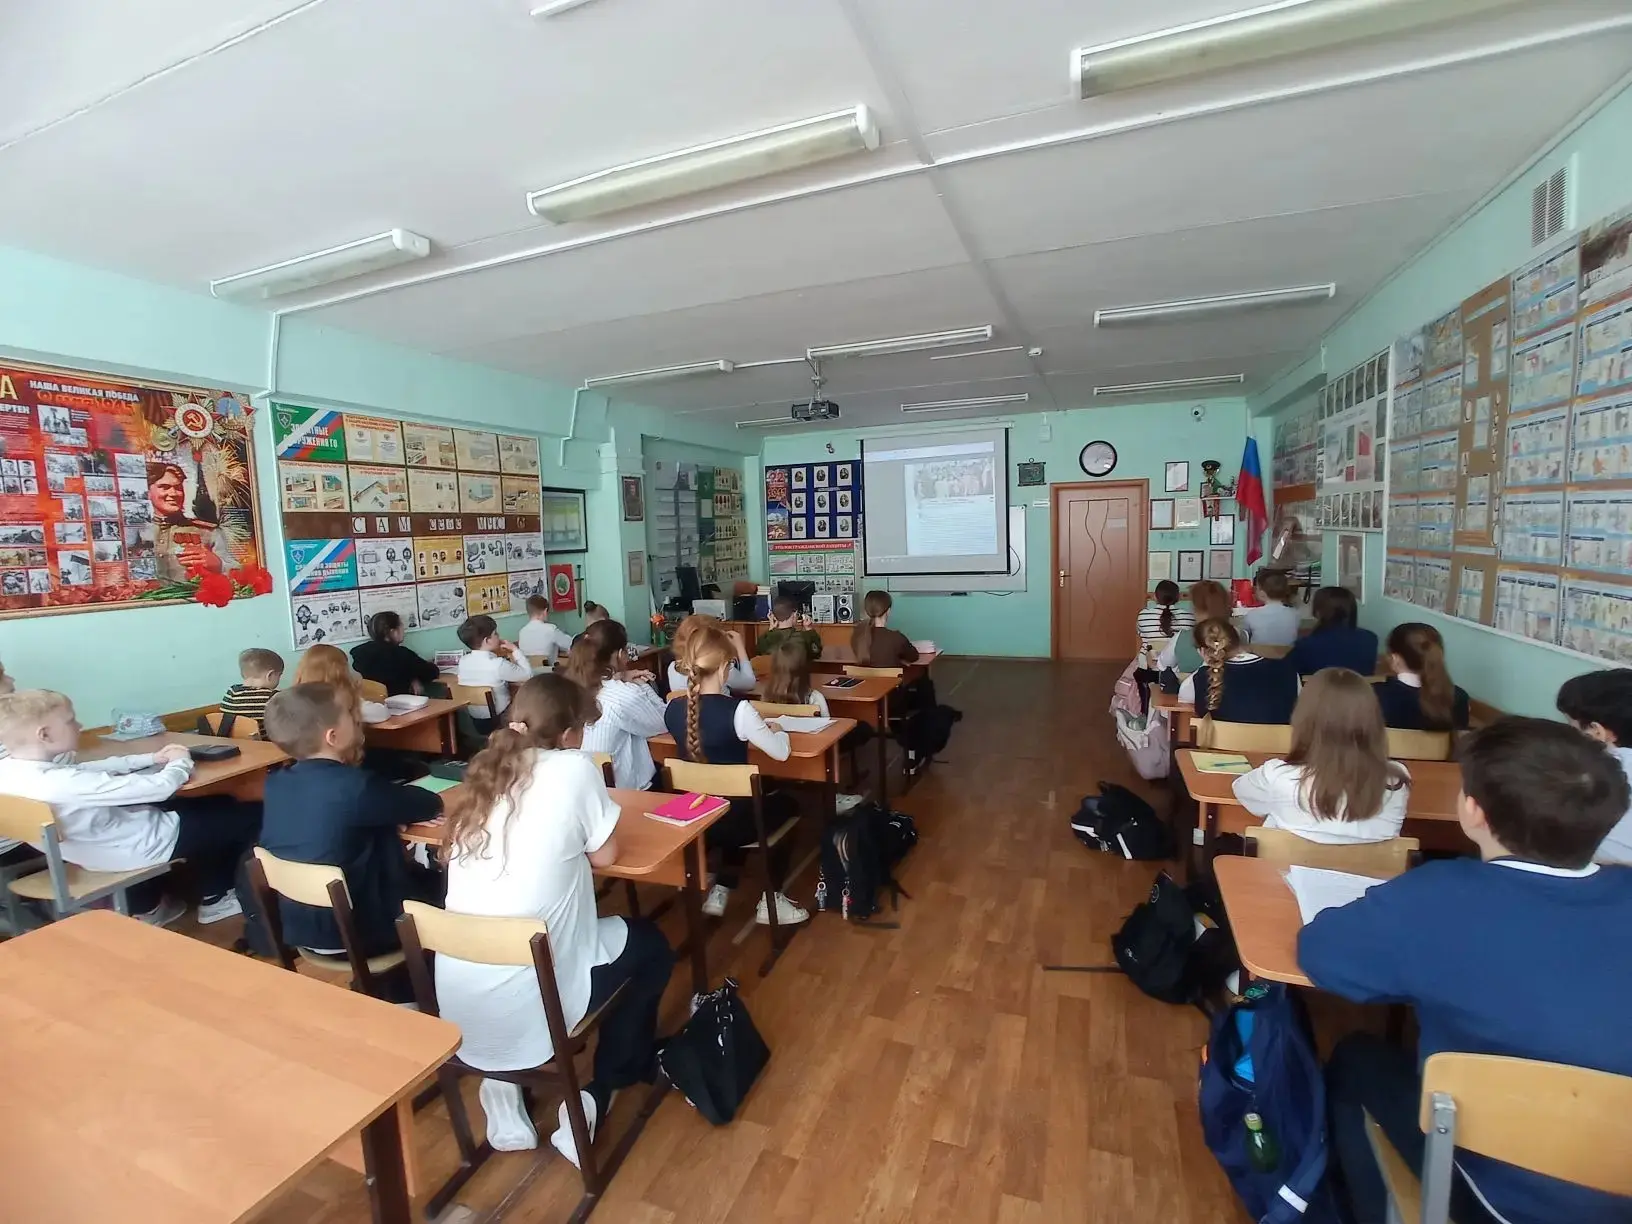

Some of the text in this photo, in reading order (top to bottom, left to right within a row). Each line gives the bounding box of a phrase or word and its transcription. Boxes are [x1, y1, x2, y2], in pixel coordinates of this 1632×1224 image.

[29, 380, 60, 392] НАША
[61, 384, 104, 397] ВЕЛИКАЯ
[105, 390, 140, 402] ПОБЕДА
